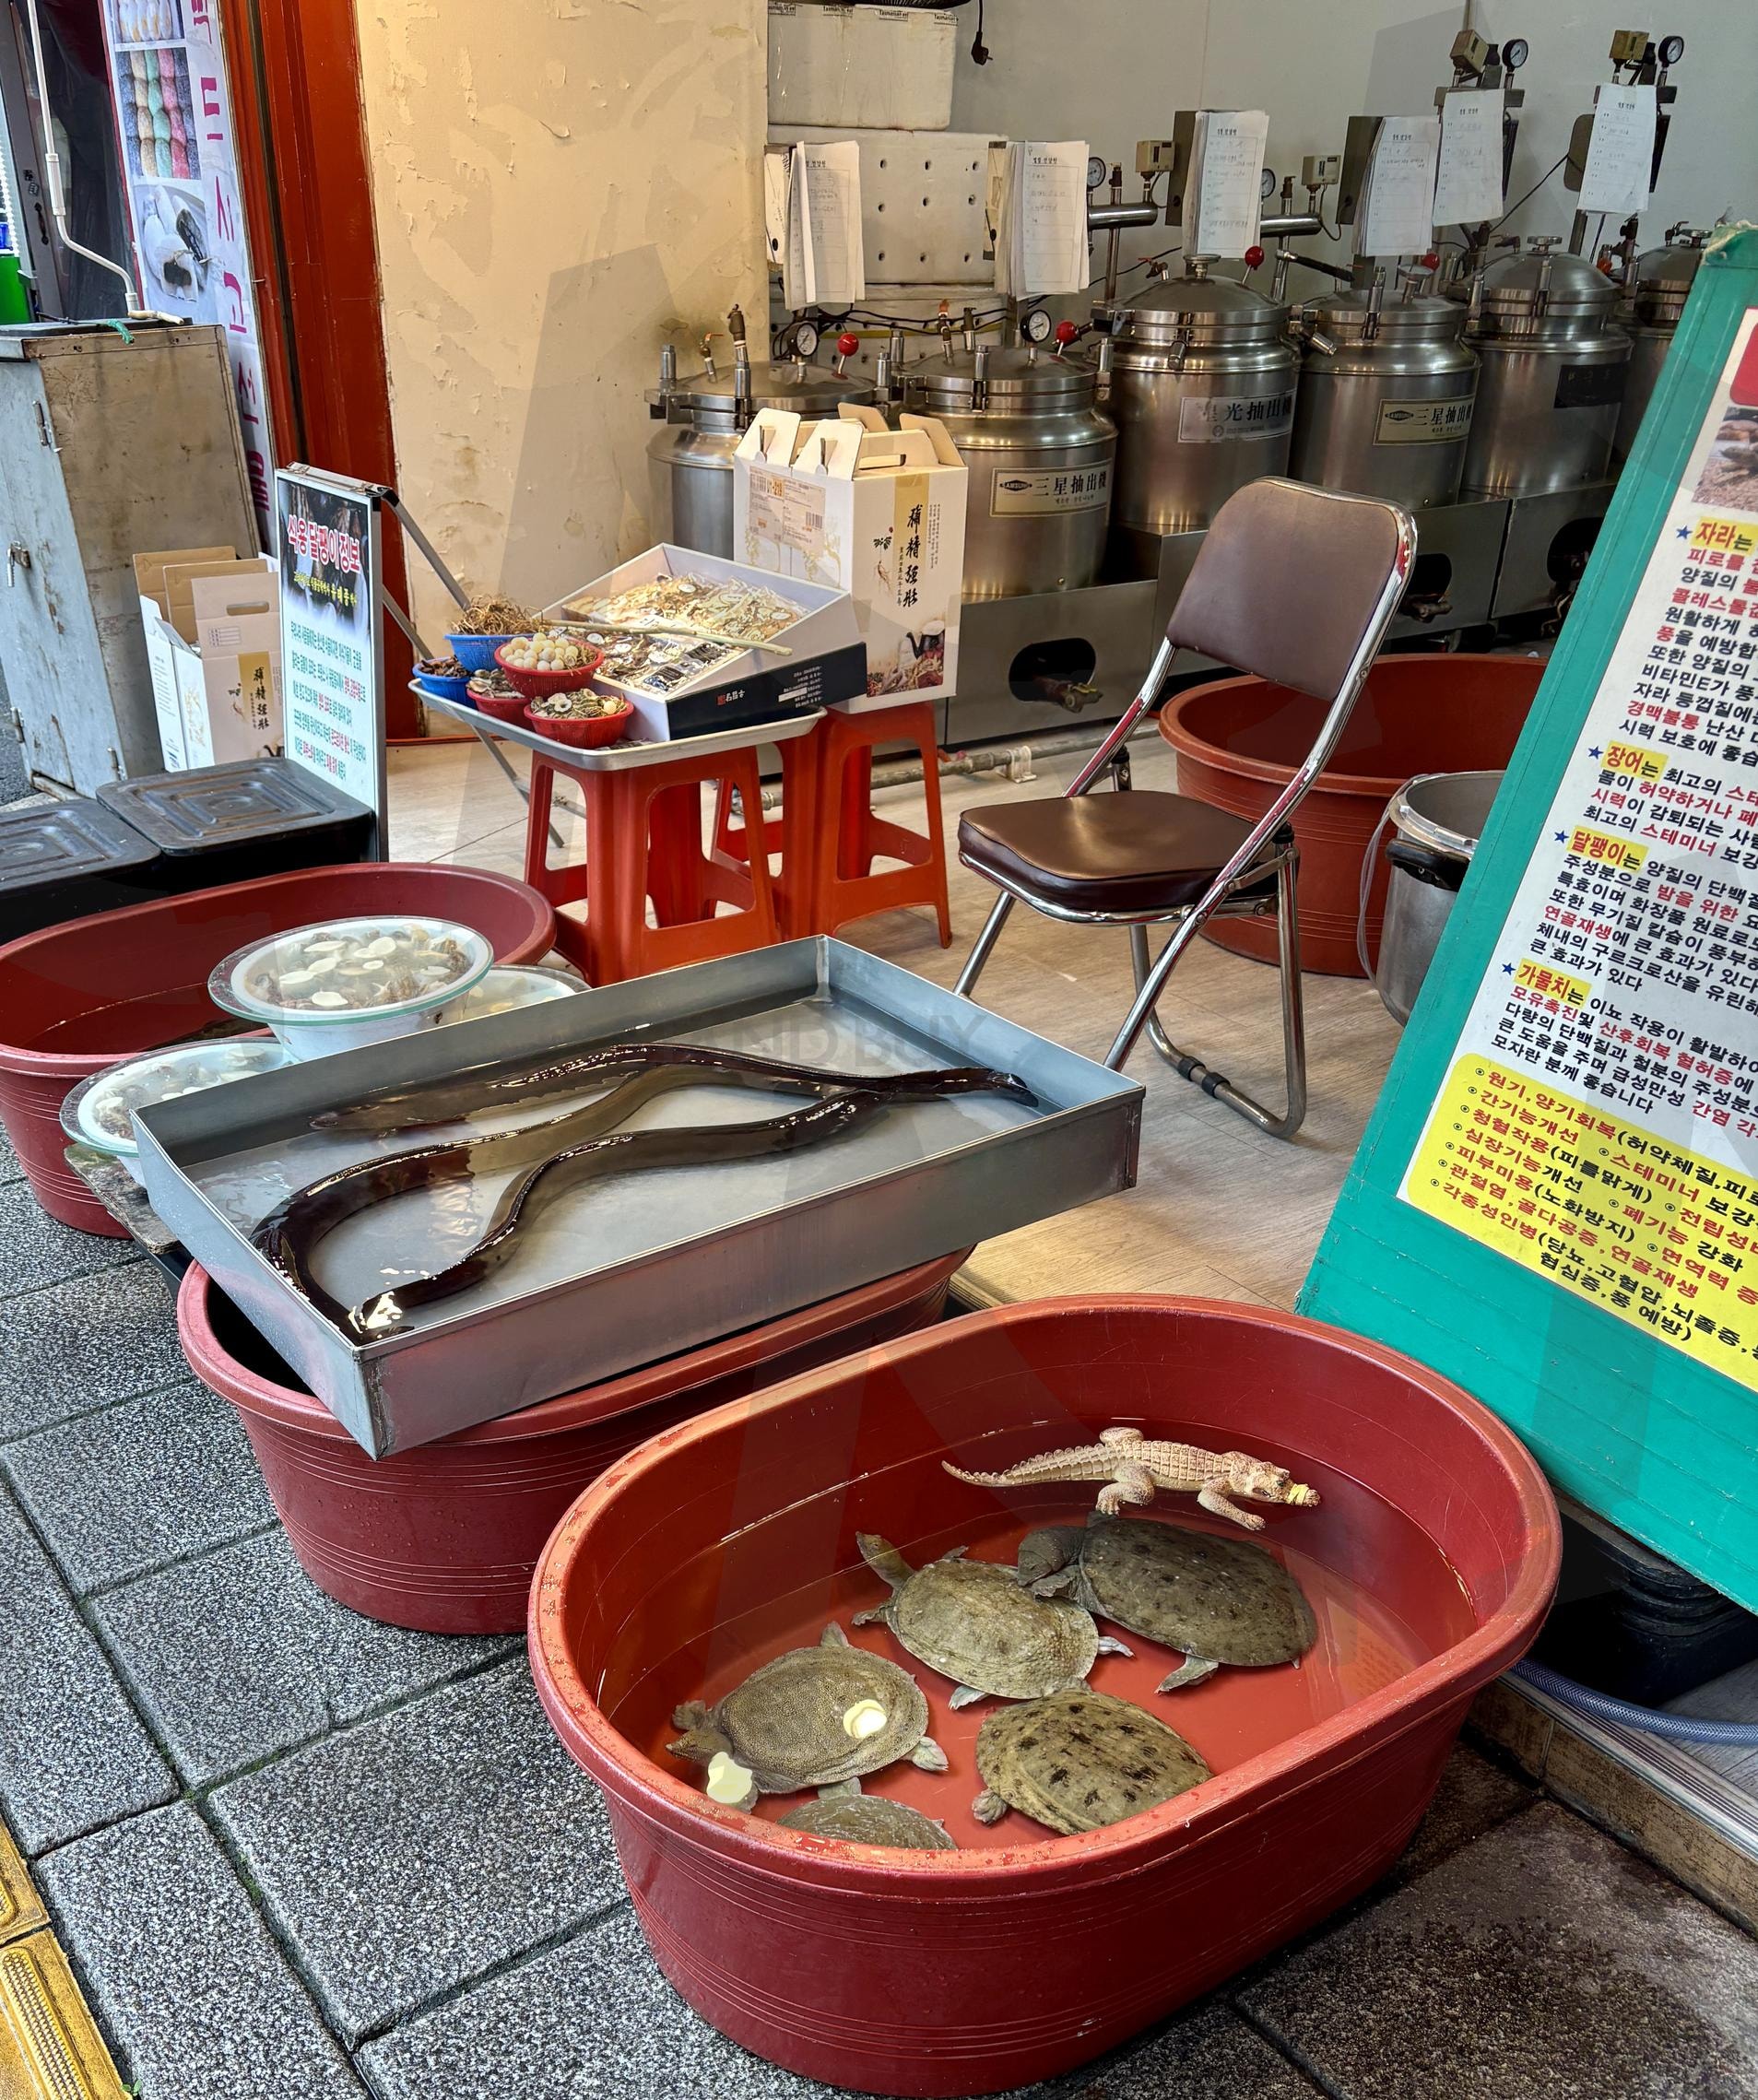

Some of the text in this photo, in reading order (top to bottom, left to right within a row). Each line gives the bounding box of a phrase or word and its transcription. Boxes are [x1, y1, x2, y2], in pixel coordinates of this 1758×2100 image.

[1687, 549, 1744, 571] 피로를
[1696, 522, 1752, 551] 자라는
[1681, 567, 1738, 591] 양질의
[1657, 626, 1693, 645] 풍을
[1665, 607, 1740, 635] 원활하게
[1642, 664, 1729, 696] 비타민E가
[1647, 645, 1750, 679] 또한 양질의
[1634, 682, 1670, 702] 자라
[1619, 719, 1656, 739] 시력
[1658, 729, 1717, 756] 보호에
[1706, 720, 1745, 741] 난산
[1598, 769, 1634, 791] 몸이
[1639, 781, 1732, 819] 허약하거나
[1607, 746, 1658, 778] 장어는
[1664, 768, 1722, 796] 최고의
[1583, 805, 1637, 832] 최고의
[1641, 823, 1717, 856] 스테미너
[1591, 788, 1645, 814] 시력이
[1650, 804, 1724, 837] 감퇴되는
[1571, 831, 1640, 870] 달팽이는
[1646, 861, 1703, 890] 양질의
[1557, 871, 1626, 905] 특효이며
[1630, 896, 1686, 926] 화장품
[1563, 854, 1652, 893] 주성분으로
[1700, 899, 1739, 923] 위한
[1549, 889, 1585, 911] 또한
[1588, 901, 1644, 931] 무기질
[1647, 921, 1704, 952] 칼슘이
[1530, 938, 1643, 992] 큰 효과가 있다
[1537, 922, 1588, 950] 체내의
[1592, 942, 1701, 993] 구르크로산을
[1543, 904, 1758, 993] 연골재생에 큰 효과가 있다
[1518, 963, 1584, 1005] 가물치는
[1590, 998, 1622, 1021] 이뇨
[1630, 1013, 1684, 1045] 작용이
[1505, 1002, 1554, 1032] 다량의
[1559, 1023, 1627, 1062] 단백질과
[1634, 1055, 1688, 1088] 철분의
[1600, 1021, 1671, 1060] 산후회복
[1491, 1034, 1653, 1115] 모자란 분께 좋습니다
[1498, 1017, 1758, 1138] 큰 도움을 주며 급성만성 간염 각
[1481, 1090, 1579, 1145] 간기능개선
[1611, 1154, 1700, 1202] 스테미너
[1466, 1128, 1583, 1194] 심장기능개선
[1697, 1241, 1743, 1272] 강화
[1662, 1247, 1729, 1291] 면역력
[1638, 1305, 1692, 1341] 예방)
